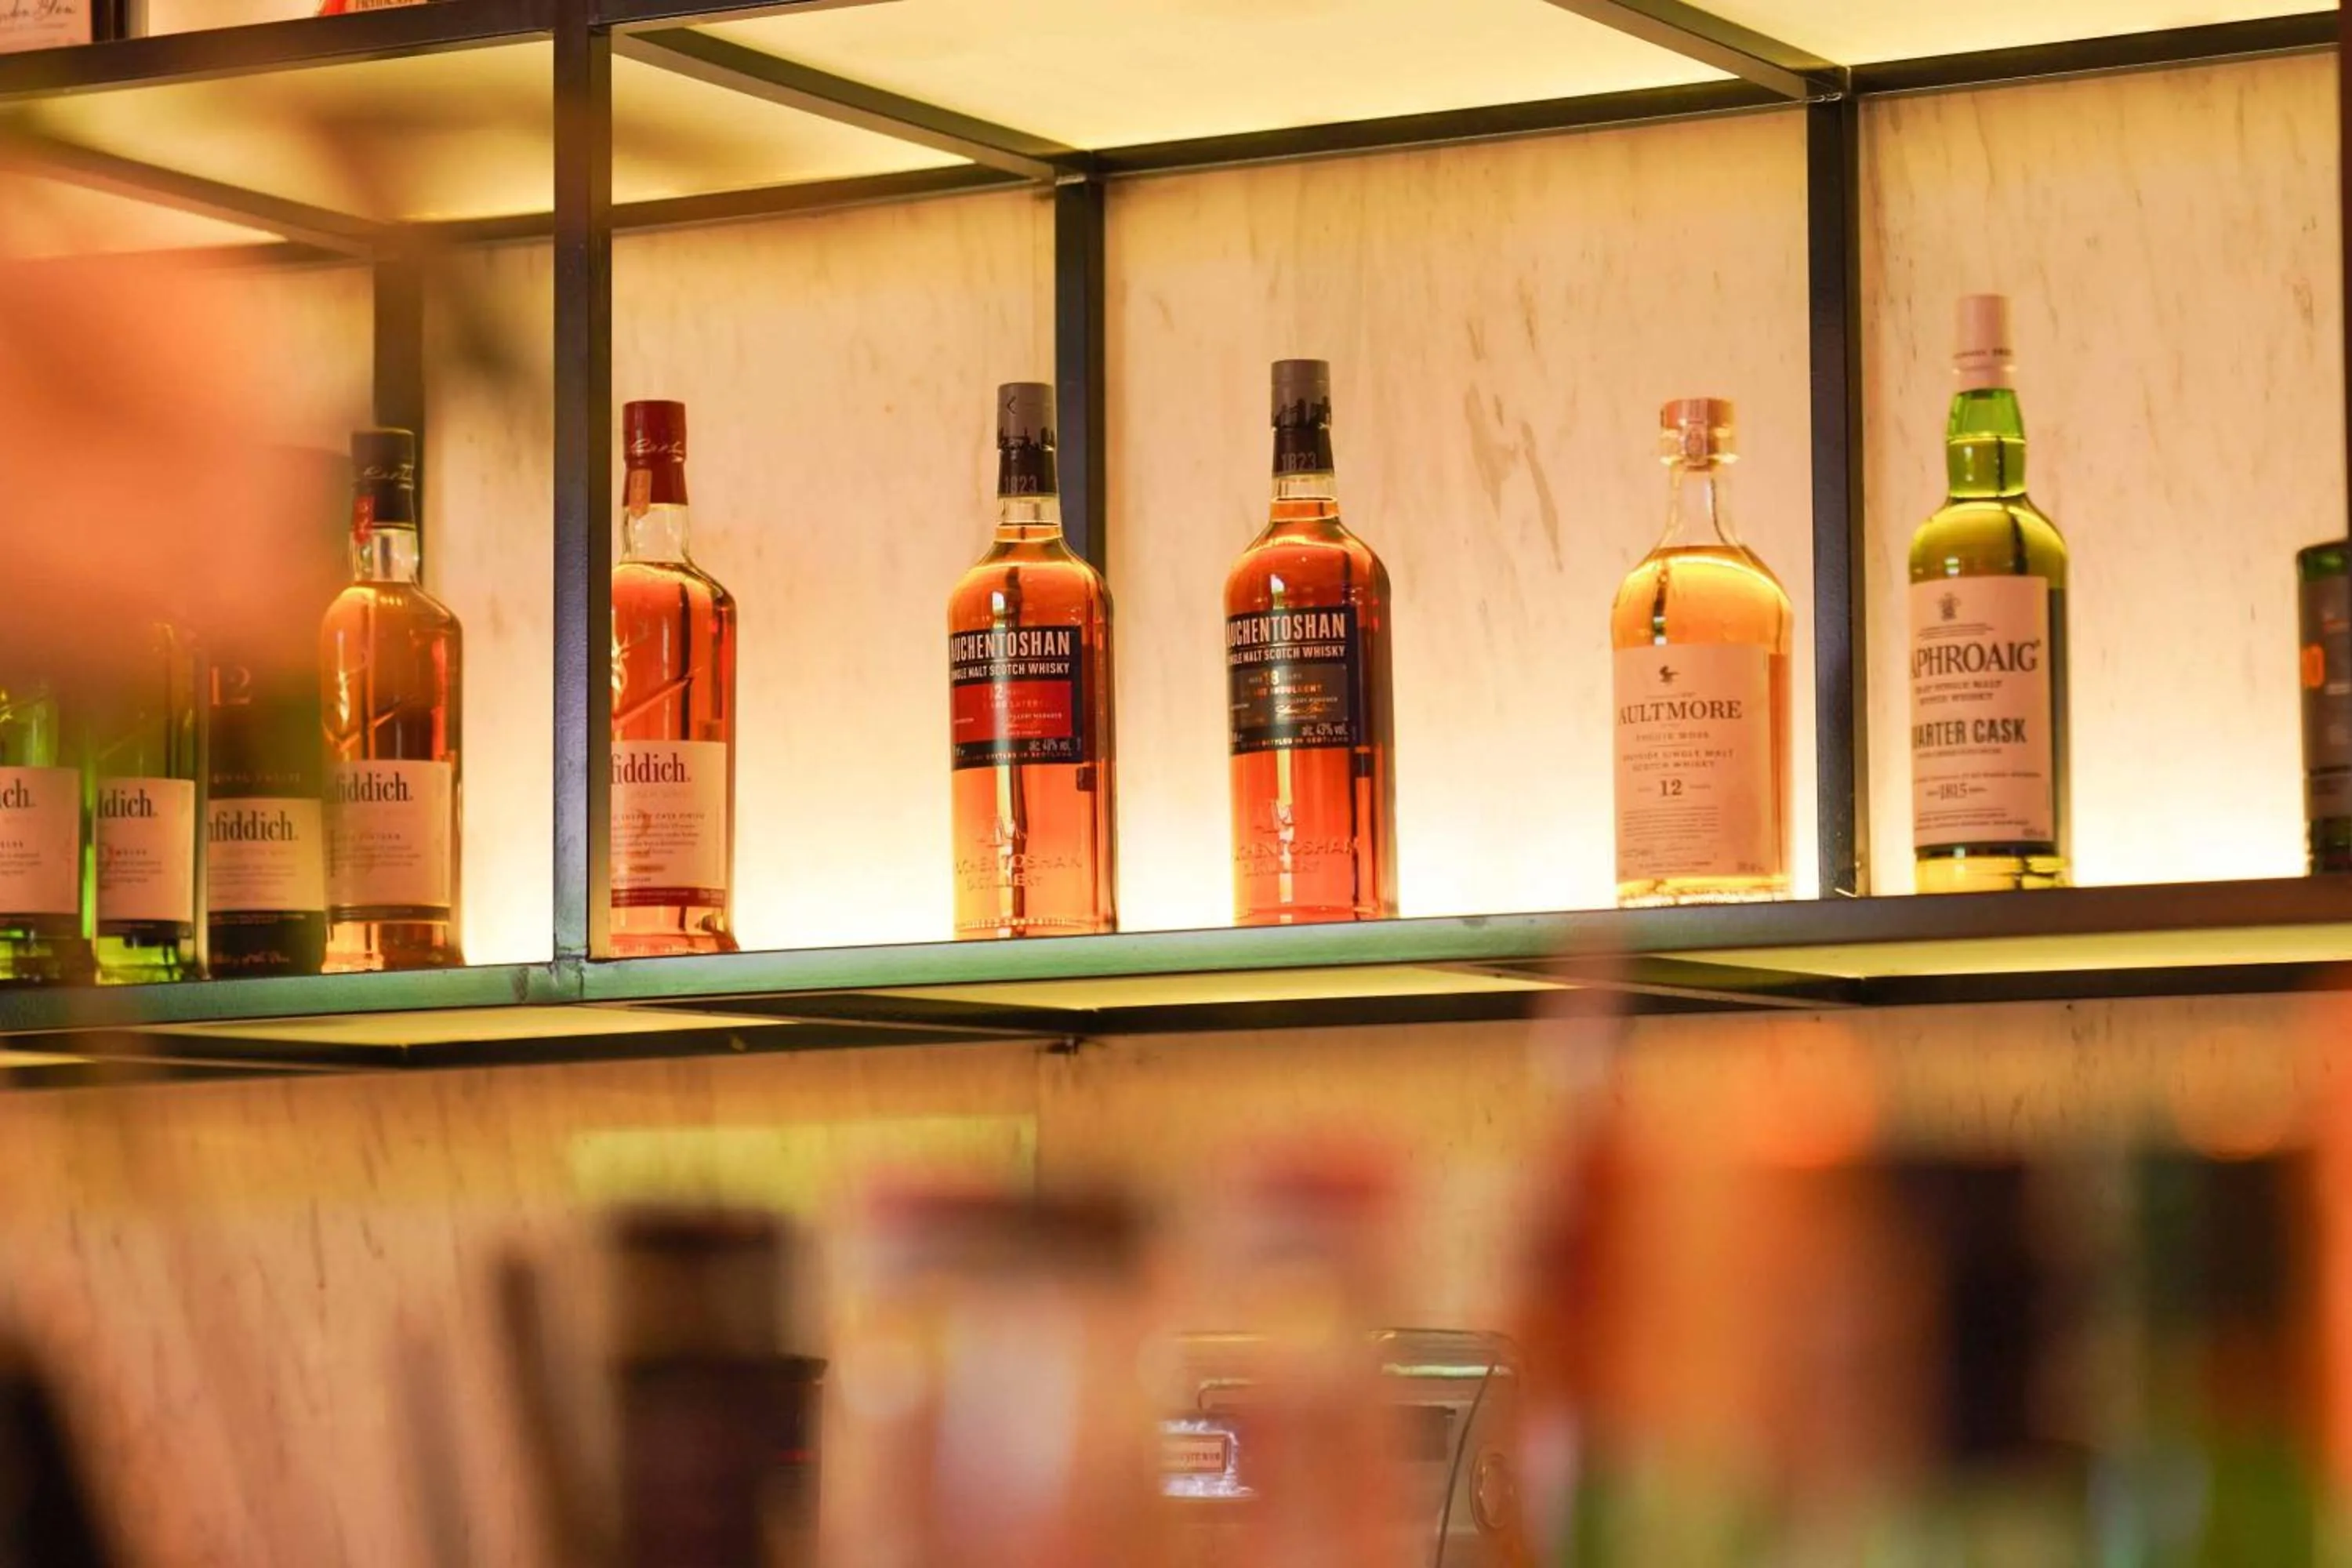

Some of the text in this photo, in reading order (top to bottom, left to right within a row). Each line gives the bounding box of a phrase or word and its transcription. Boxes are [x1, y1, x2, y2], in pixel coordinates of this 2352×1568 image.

[1243, 649, 1262, 662] MALT
[1264, 647, 1300, 661] SCOTCH
[1302, 645, 1346, 658] WHISKY
[1911, 641, 2039, 679] APHROAIG
[968, 666, 988, 678] MALT
[989, 663, 1025, 677] SCOTCH
[1028, 662, 1070, 674] WHISKY
[212, 666, 252, 706] 12
[1618, 700, 1743, 726] AULTMORE
[1973, 718, 2027, 744] CASK
[611, 752, 691, 784] fiddich.
[1660, 779, 1682, 797] 12
